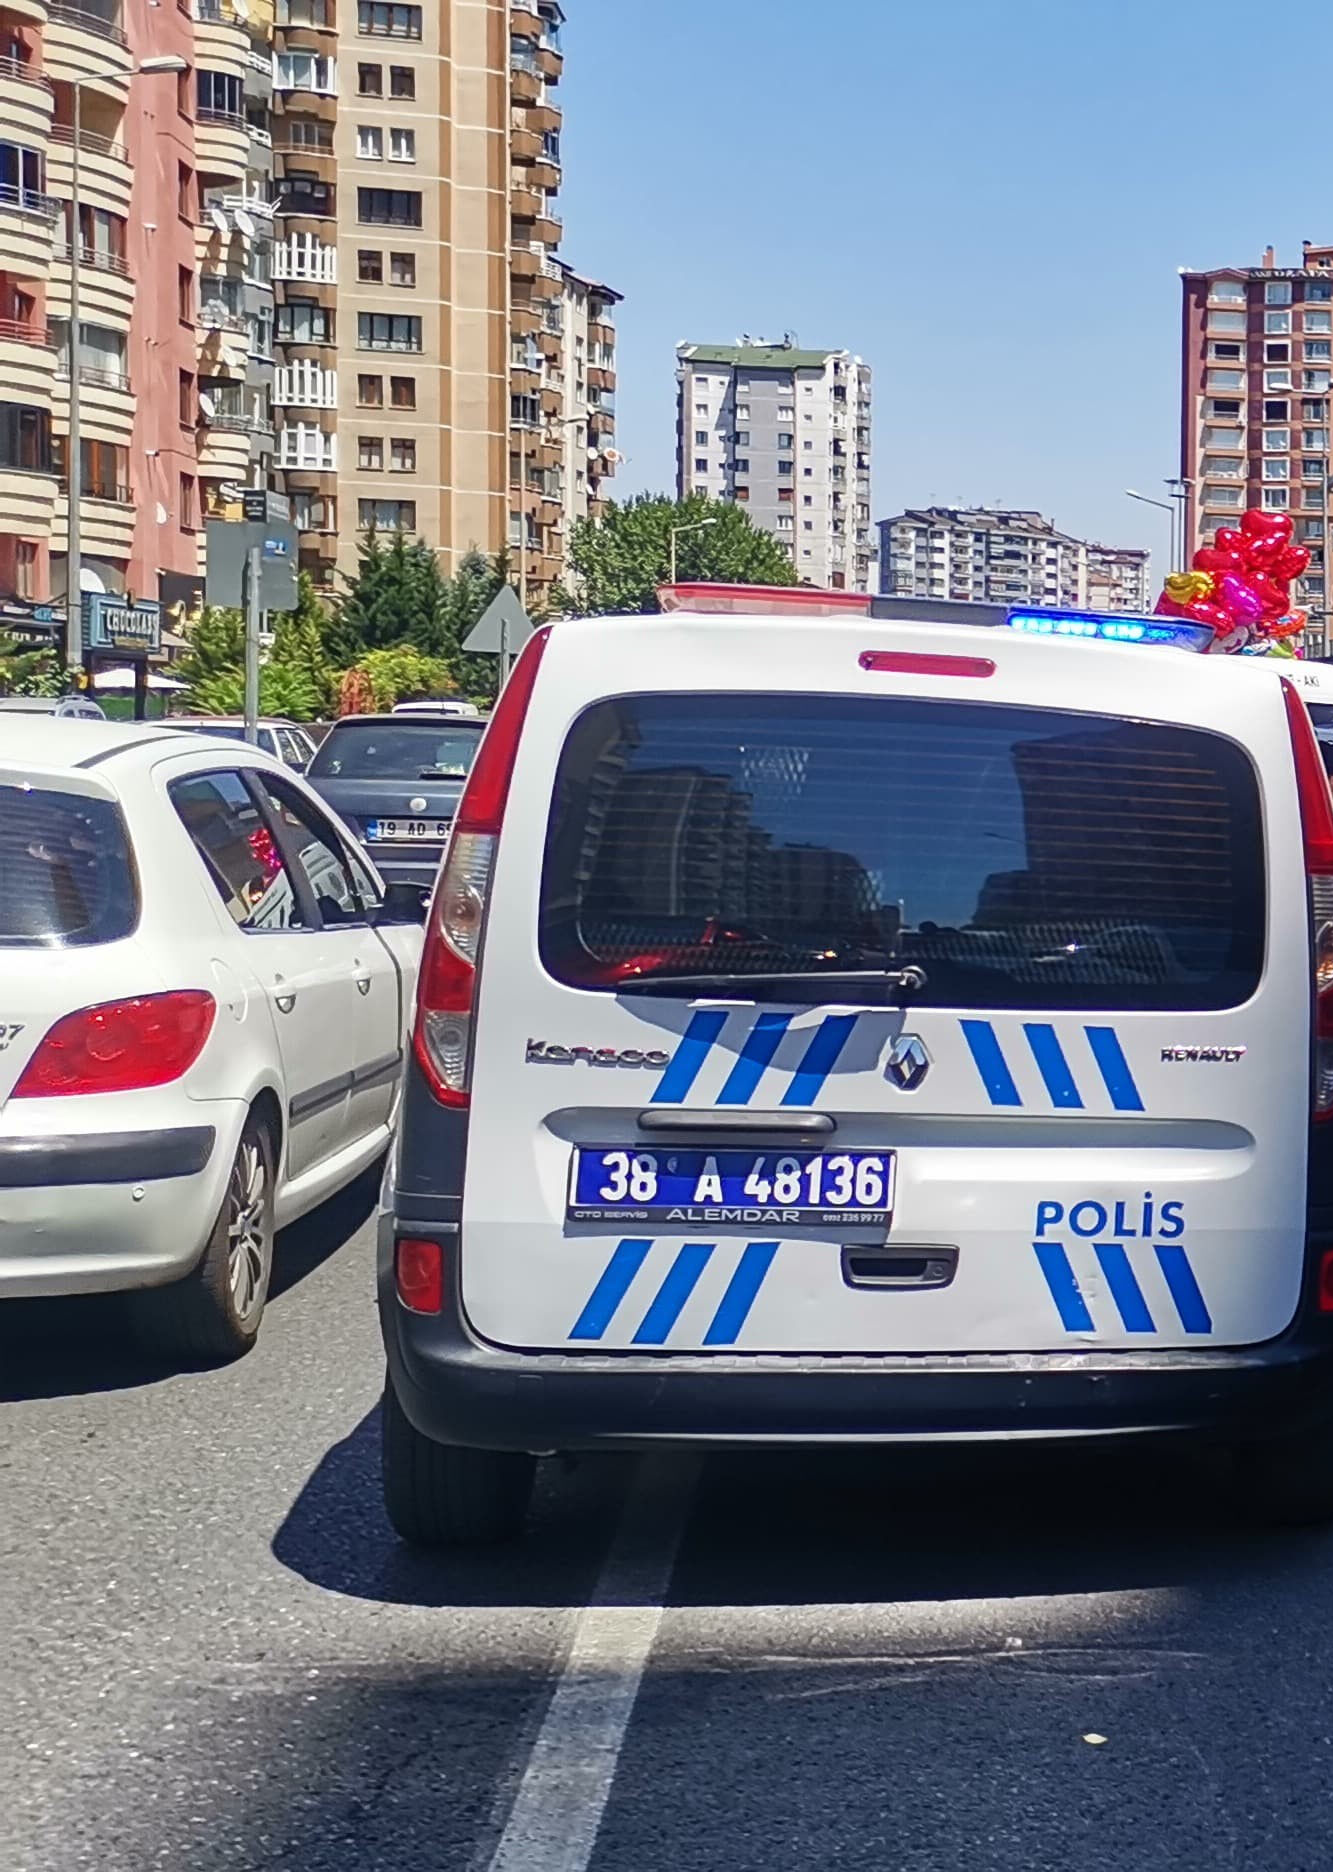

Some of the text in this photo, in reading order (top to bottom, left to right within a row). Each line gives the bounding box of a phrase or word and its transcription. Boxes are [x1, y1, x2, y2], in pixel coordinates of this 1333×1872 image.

[1160, 1045, 1247, 1063] RENAULT
[600, 1152, 884, 1206] 38 A 48136
[666, 1207, 800, 1223] ALEMDAR
[1034, 1191, 1186, 1239] POLİS
